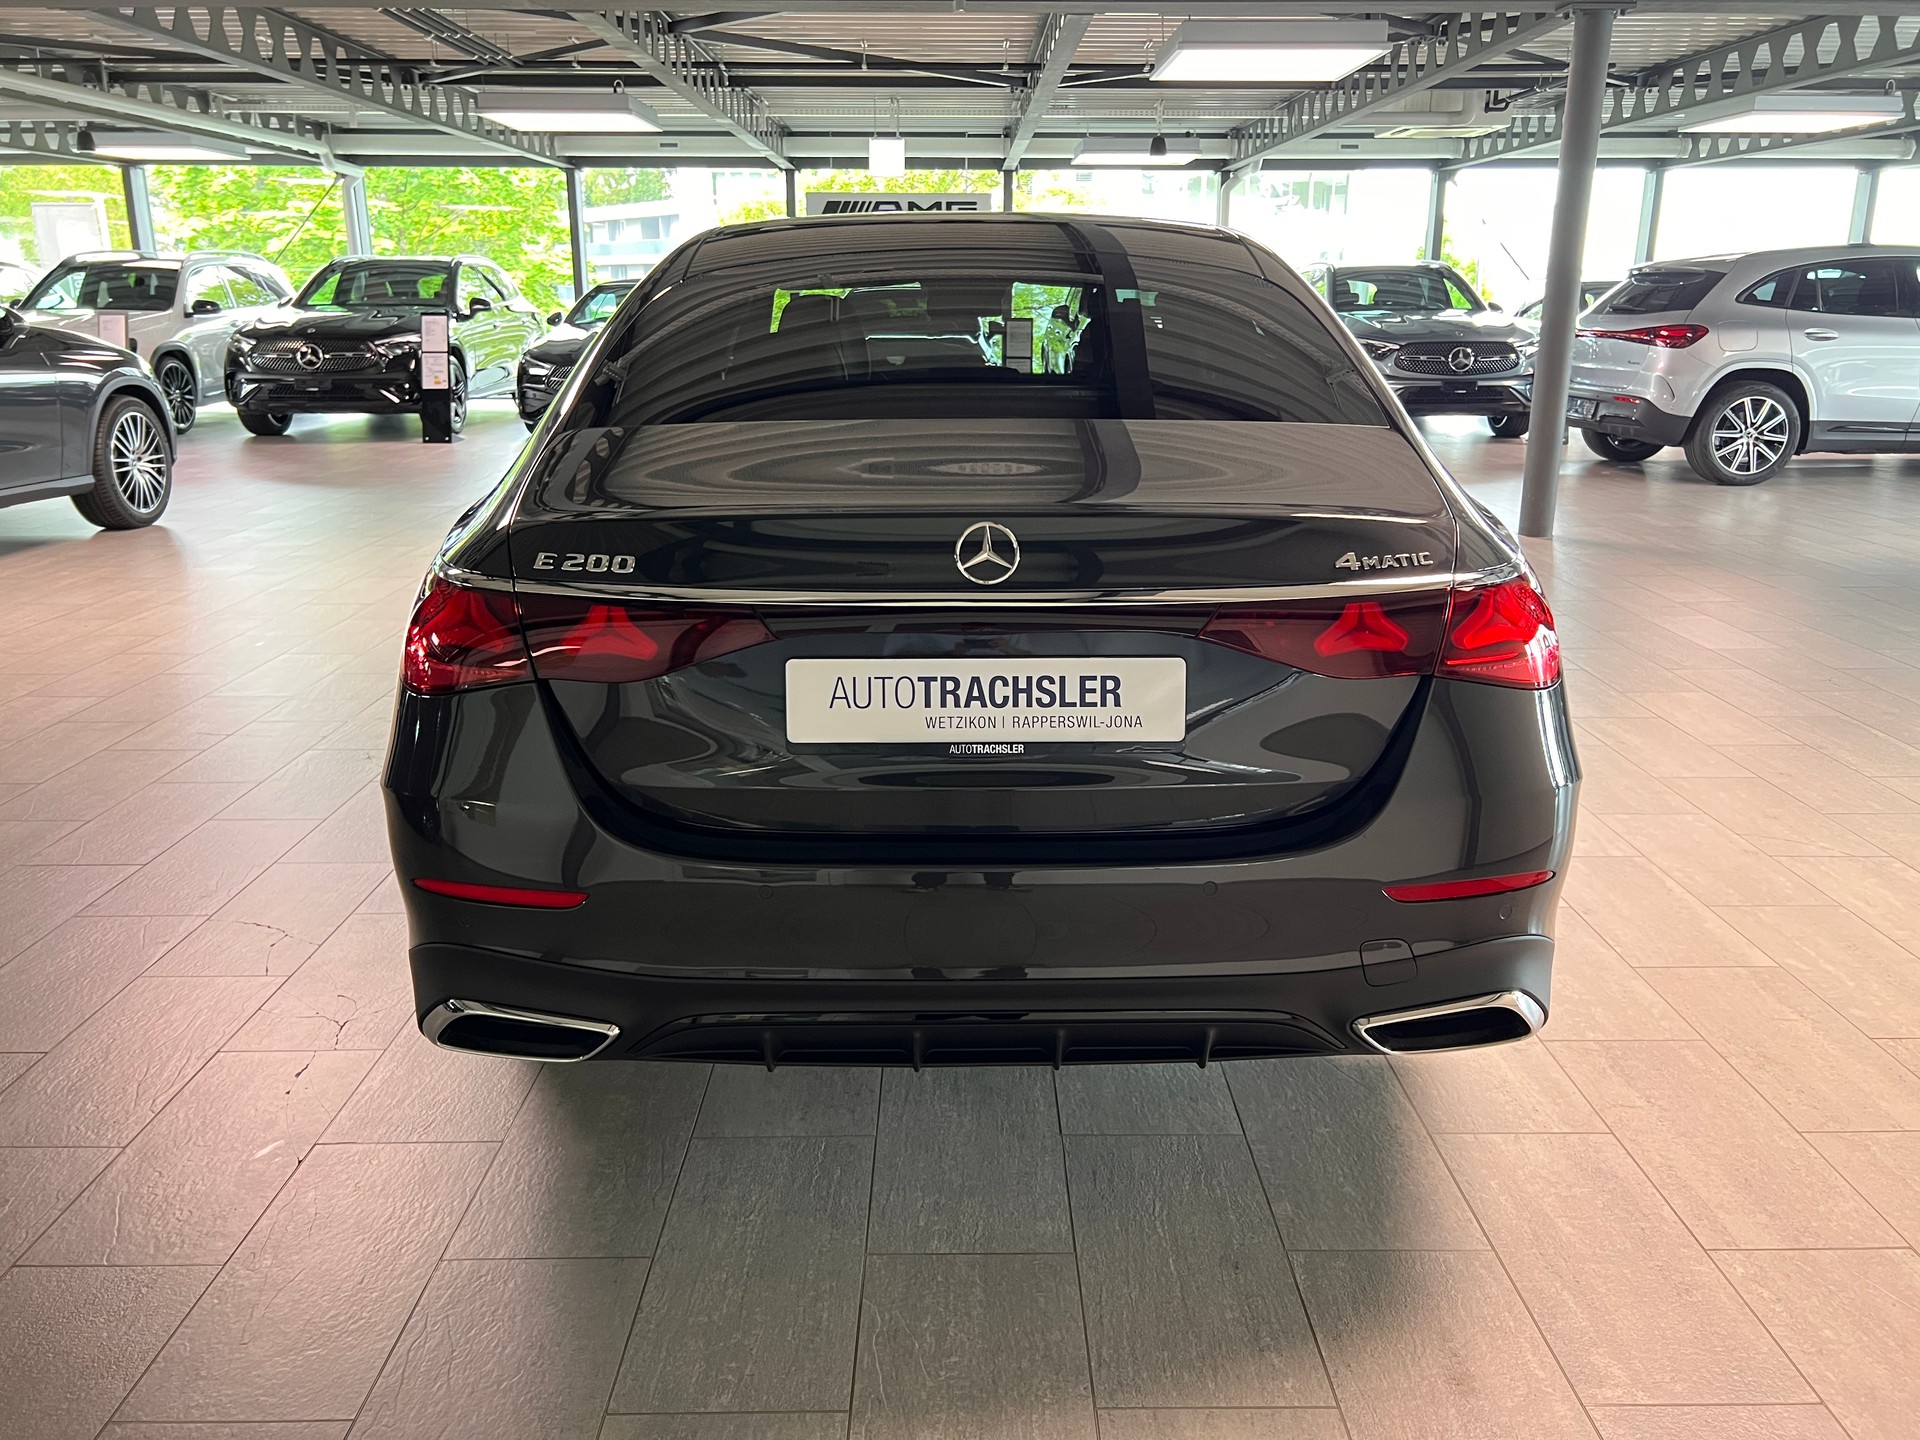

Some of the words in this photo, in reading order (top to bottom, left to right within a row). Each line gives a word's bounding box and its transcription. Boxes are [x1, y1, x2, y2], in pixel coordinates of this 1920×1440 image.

[533, 552, 558, 570] E
[561, 553, 636, 574] 200
[1335, 552, 1434, 571] 4MATIC
[829, 675, 1122, 709] AUTOTRACHSLER
[925, 715, 996, 729] WETZIKON
[1012, 715, 1143, 729] RAPPERSWIL-JONA
[949, 744, 1025, 754] AUTOTRACHSLER
